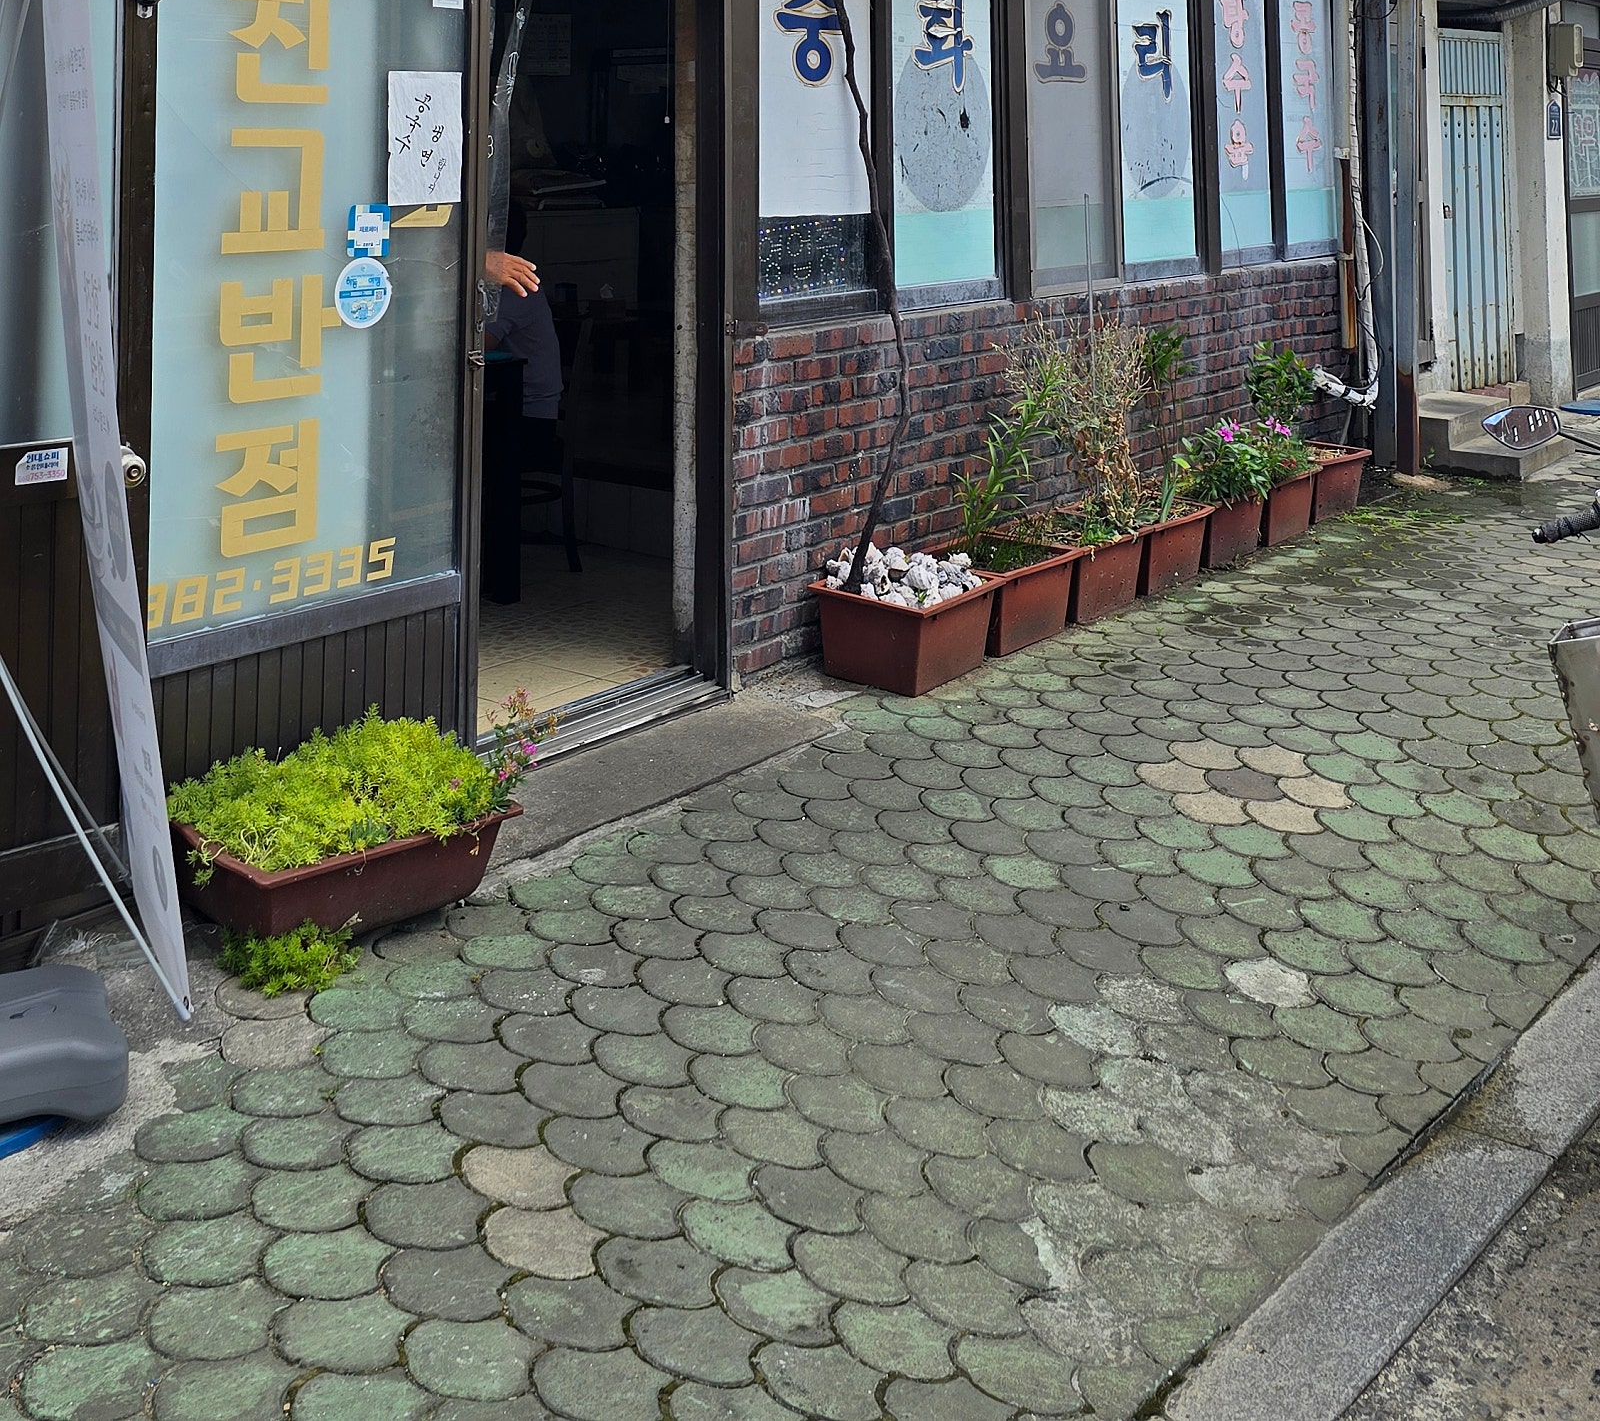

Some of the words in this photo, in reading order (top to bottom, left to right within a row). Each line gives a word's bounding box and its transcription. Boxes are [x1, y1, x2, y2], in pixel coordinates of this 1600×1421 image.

[1290, 0, 1322, 173] 콩국수
[395, 93, 432, 155] 콩국수
[1551, 119, 1559, 134] 22
